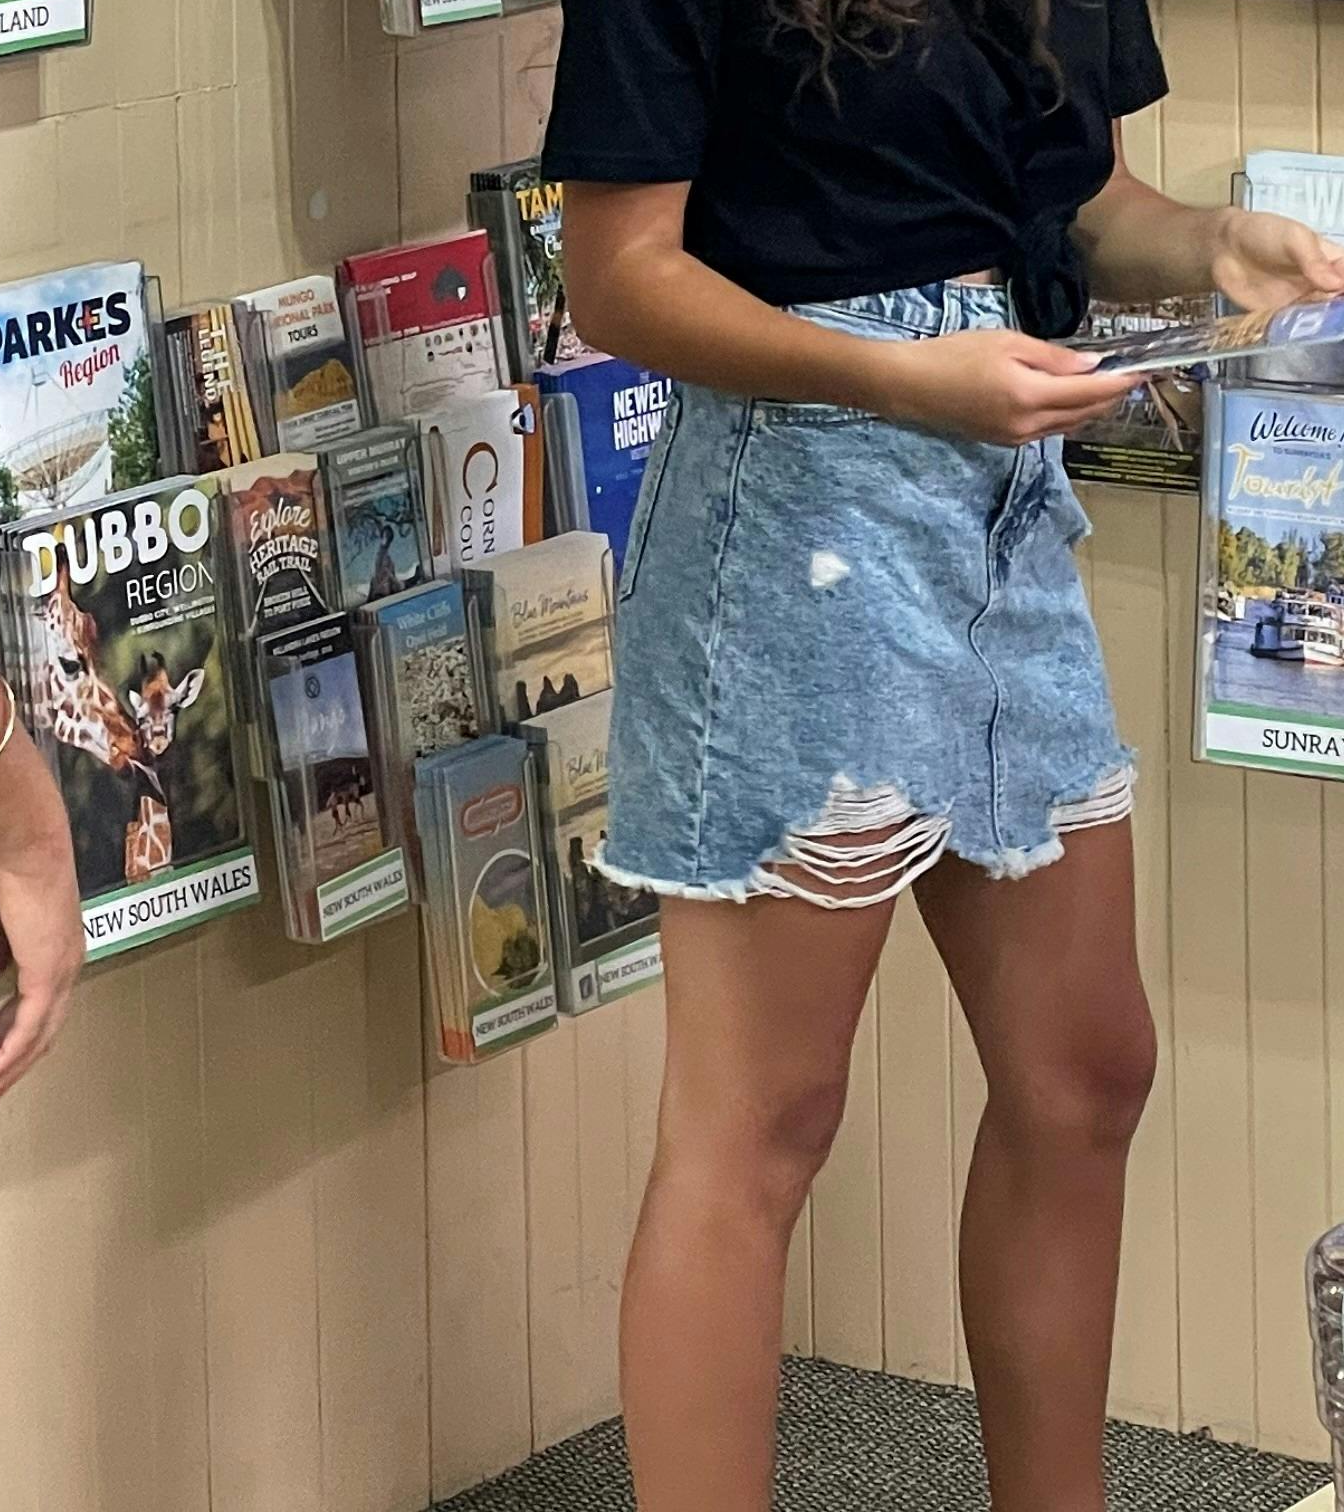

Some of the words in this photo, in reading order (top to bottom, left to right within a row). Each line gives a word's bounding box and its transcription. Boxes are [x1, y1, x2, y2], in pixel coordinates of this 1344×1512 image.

[288, 325, 319, 342] TOURS
[59, 343, 121, 390] Region
[22, 488, 209, 598] DUBBO
[248, 497, 313, 553] Explore
[249, 534, 319, 575] HERITAGE
[126, 561, 215, 609] REGION
[128, 888, 188, 924] SOUTH
[190, 865, 252, 902] WALES
[344, 886, 370, 910] SOUTH
[371, 868, 403, 894] WALES
[623, 961, 648, 981] SOUTH
[498, 1006, 525, 1029] SOUTH
[525, 993, 554, 1018] WALES
